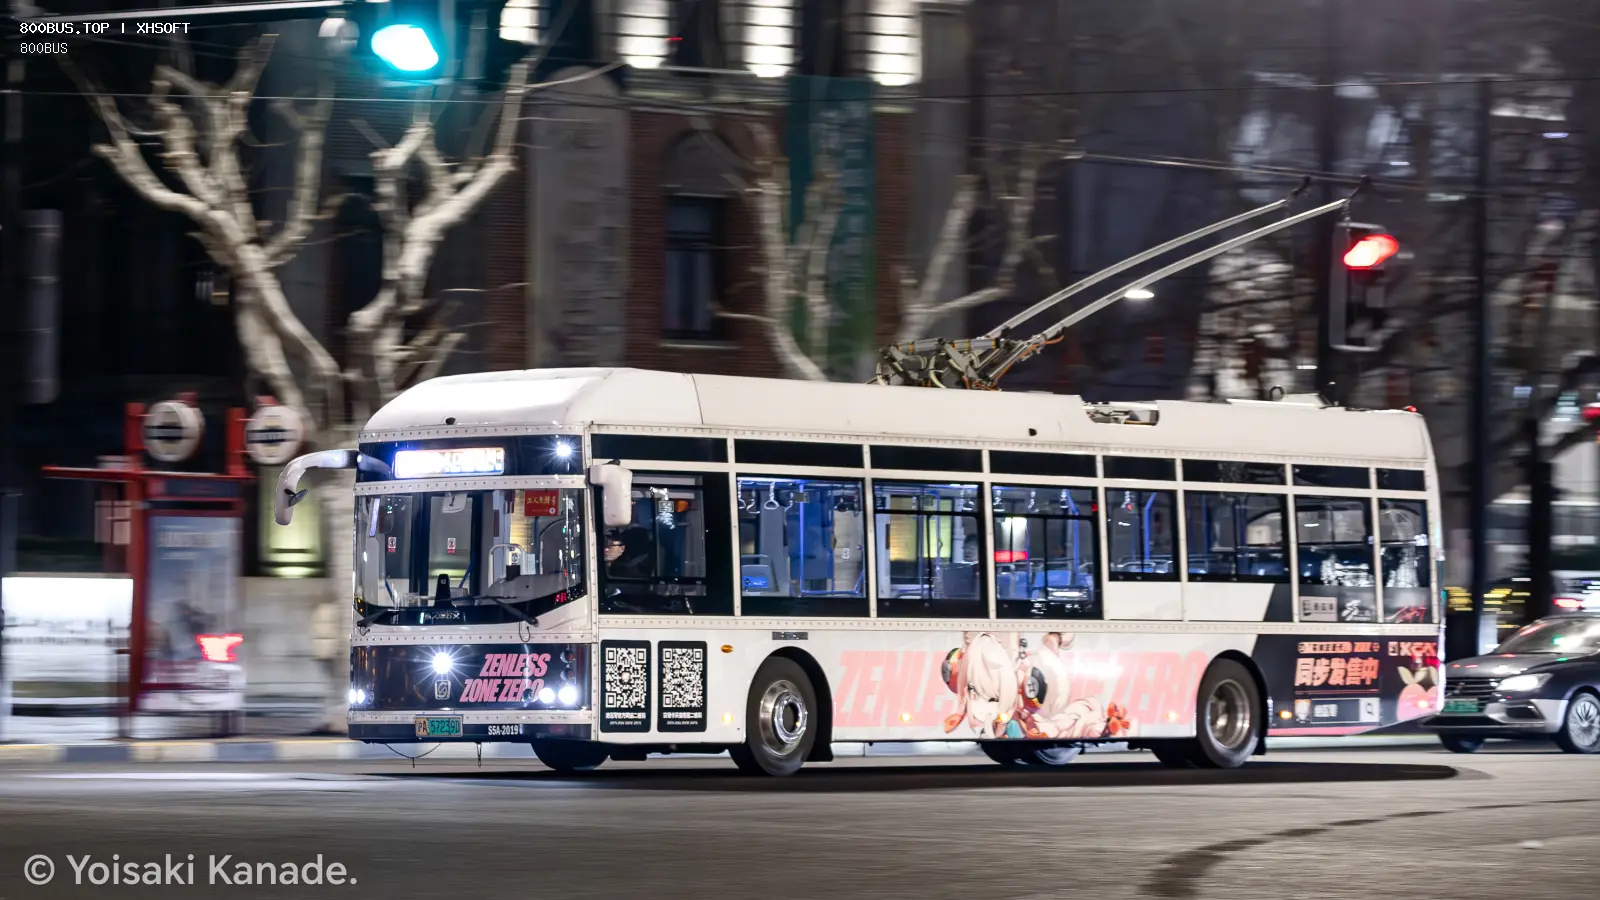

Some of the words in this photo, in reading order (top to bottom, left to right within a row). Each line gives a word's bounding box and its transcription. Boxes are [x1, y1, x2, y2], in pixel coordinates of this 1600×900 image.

[479, 653, 551, 677] ZENLESS
[1294, 657, 1379, 686] 同步发售中
[459, 678, 503, 702] ZONE
[1106, 650, 1208, 725] ZERO
